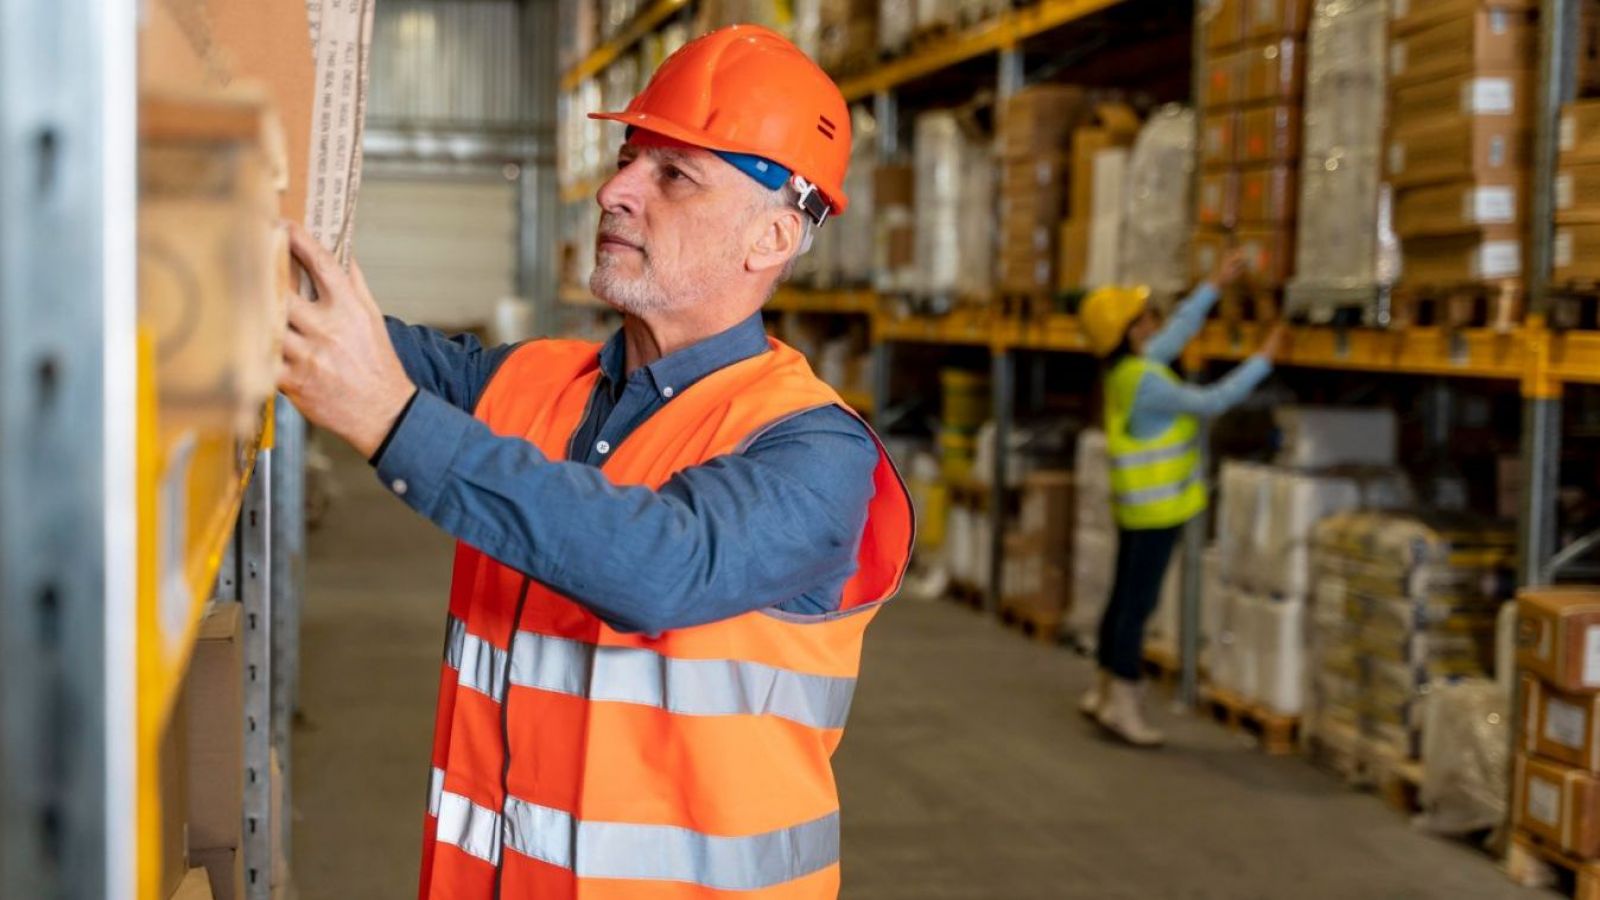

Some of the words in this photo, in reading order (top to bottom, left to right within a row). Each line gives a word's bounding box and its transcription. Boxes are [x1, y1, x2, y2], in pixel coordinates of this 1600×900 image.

[327, 50, 337, 67] THIS
[323, 93, 332, 109] HAS
[321, 111, 331, 133] BEEN
[318, 134, 329, 175] TAMPERED
[313, 199, 324, 227] PLEASE
